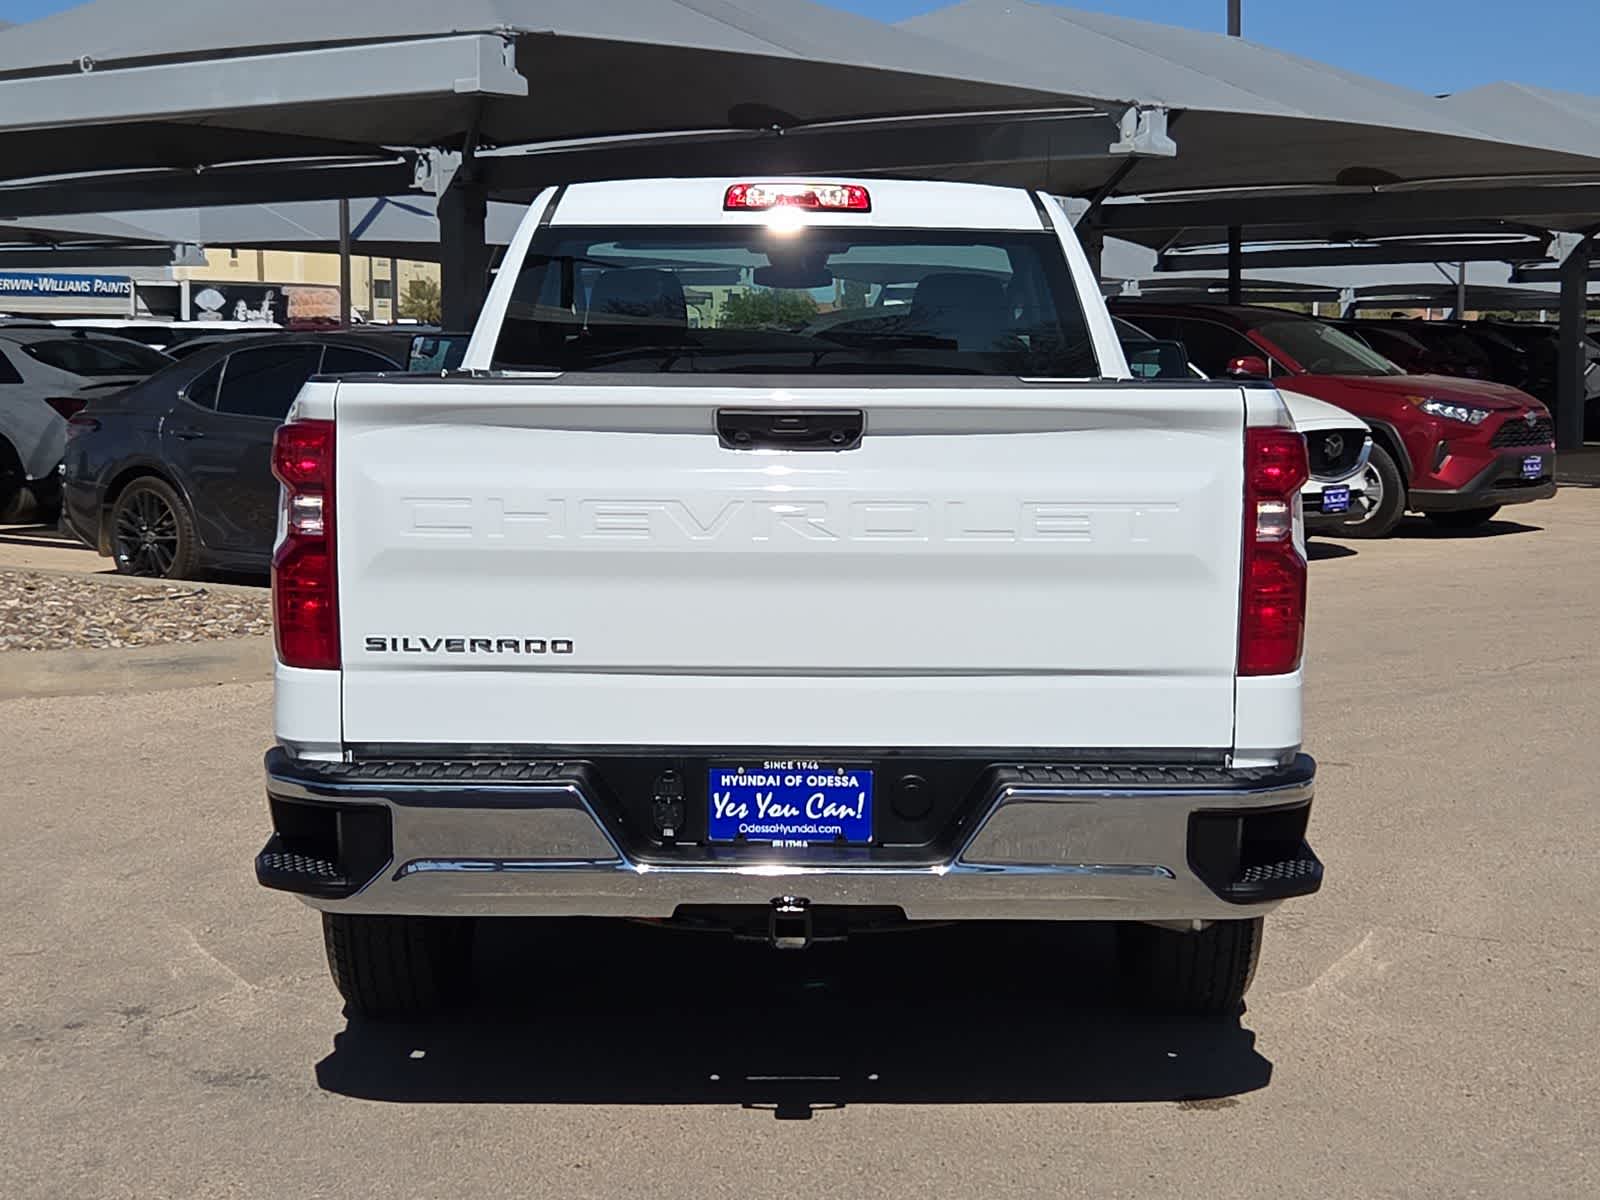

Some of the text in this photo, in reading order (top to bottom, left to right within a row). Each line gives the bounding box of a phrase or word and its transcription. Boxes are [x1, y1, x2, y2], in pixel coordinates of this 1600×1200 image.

[93, 279, 131, 293] PAINTS
[399, 496, 1182, 542] CHEVROLET
[364, 637, 574, 654] SILVERADO
[763, 761, 819, 770] SINCE 1946
[721, 775, 859, 788] HYUNDAI OF ODESSA
[713, 791, 865, 819] Yes You Can!
[738, 823, 842, 835] OdessaHyundai.com
